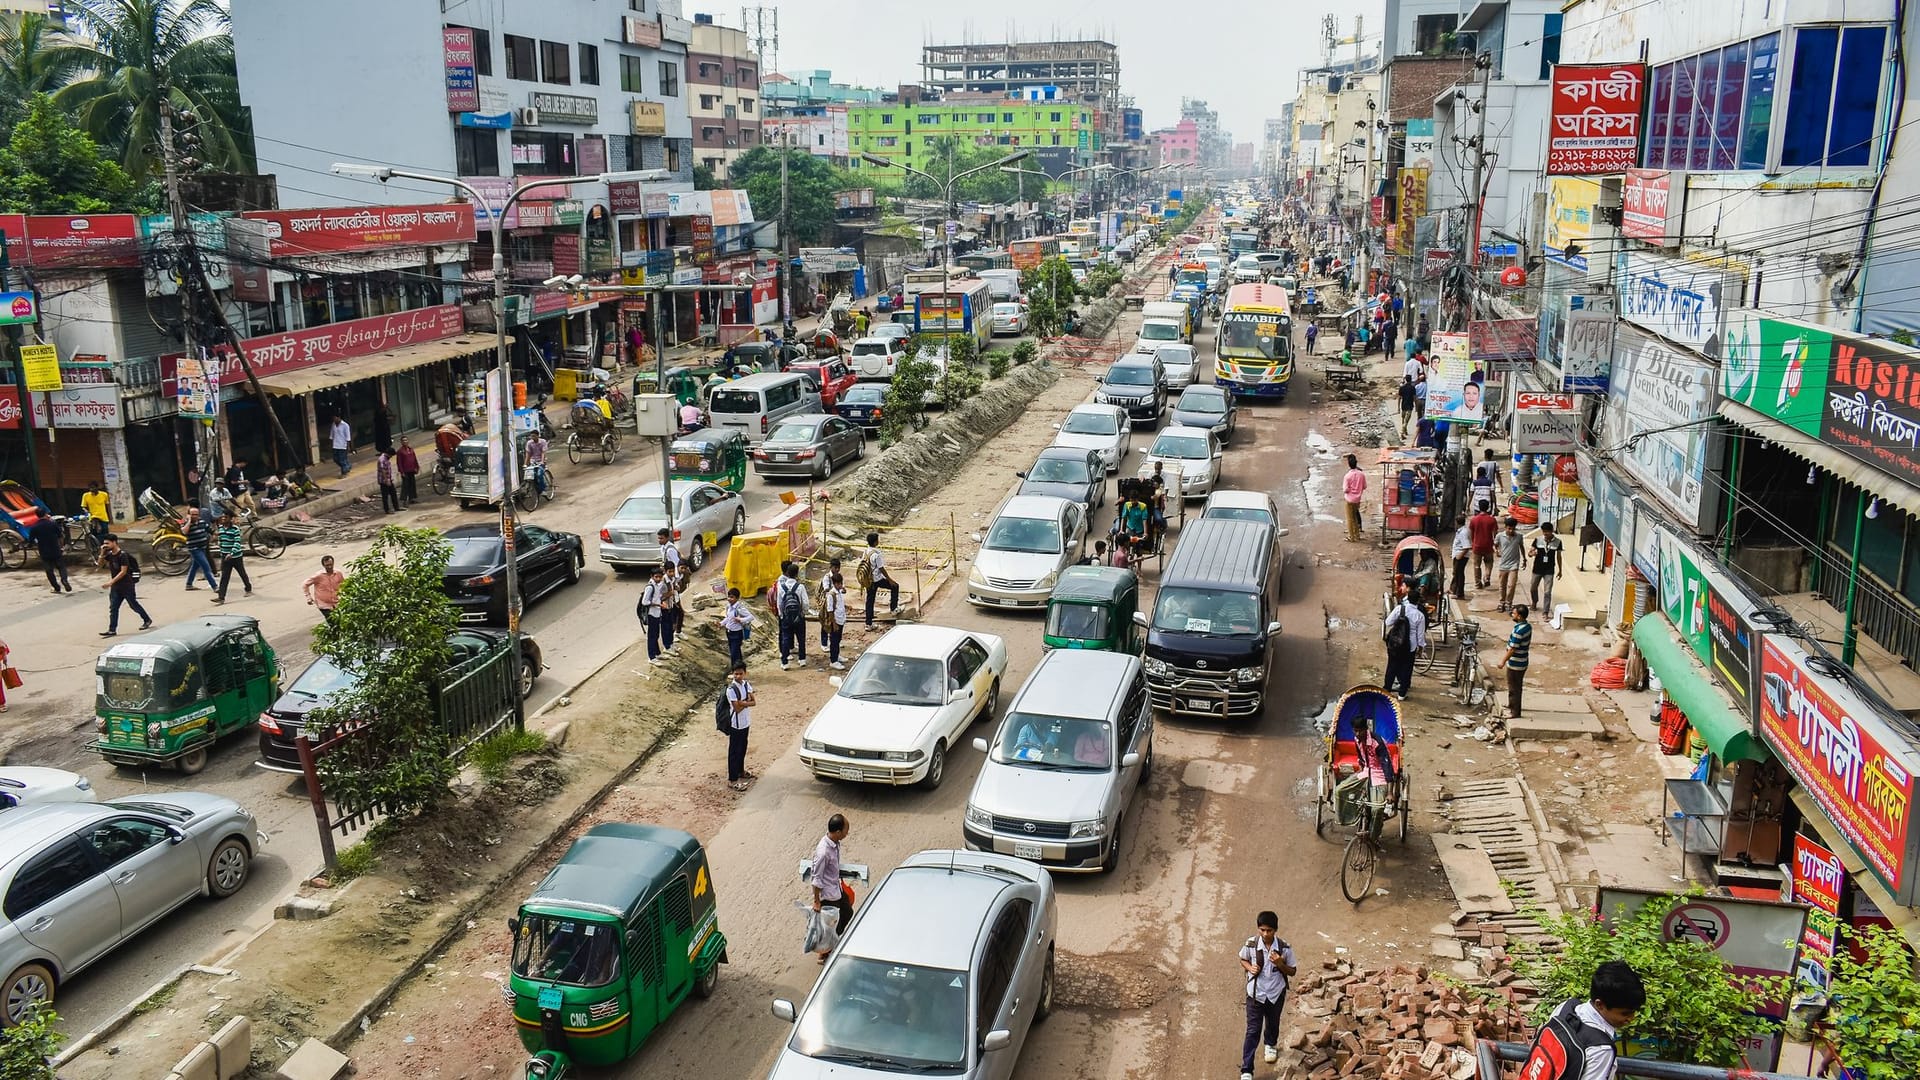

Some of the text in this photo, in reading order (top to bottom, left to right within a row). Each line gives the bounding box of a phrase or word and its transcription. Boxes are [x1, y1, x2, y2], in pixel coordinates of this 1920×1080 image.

[1557, 71, 1642, 103] কাজী
[1554, 106, 1639, 136] অফিস
[1551, 150, 1636, 160] ০১৭১৮-৪৪২২৮৪
[423, 211, 456, 225] বাংলাদেশ
[337, 327, 380, 349] Asian
[370, 317, 405, 348] fast
[397, 312, 437, 344] food
[1233, 314, 1281, 325] ANABIL
[251, 336, 297, 367] ফাস্ট
[302, 335, 333, 361] ফুড
[1647, 346, 1694, 394] Blue
[35, 400, 71, 417] এিয়ান
[1635, 369, 1690, 419] Gent's Salon
[1787, 680, 1864, 802] শ্যামলী
[1863, 754, 1907, 840] পরিবহন
[694, 866, 708, 899] 4
[1797, 846, 1844, 896] শ্যামলী
[570, 1012, 588, 1027] CNG
